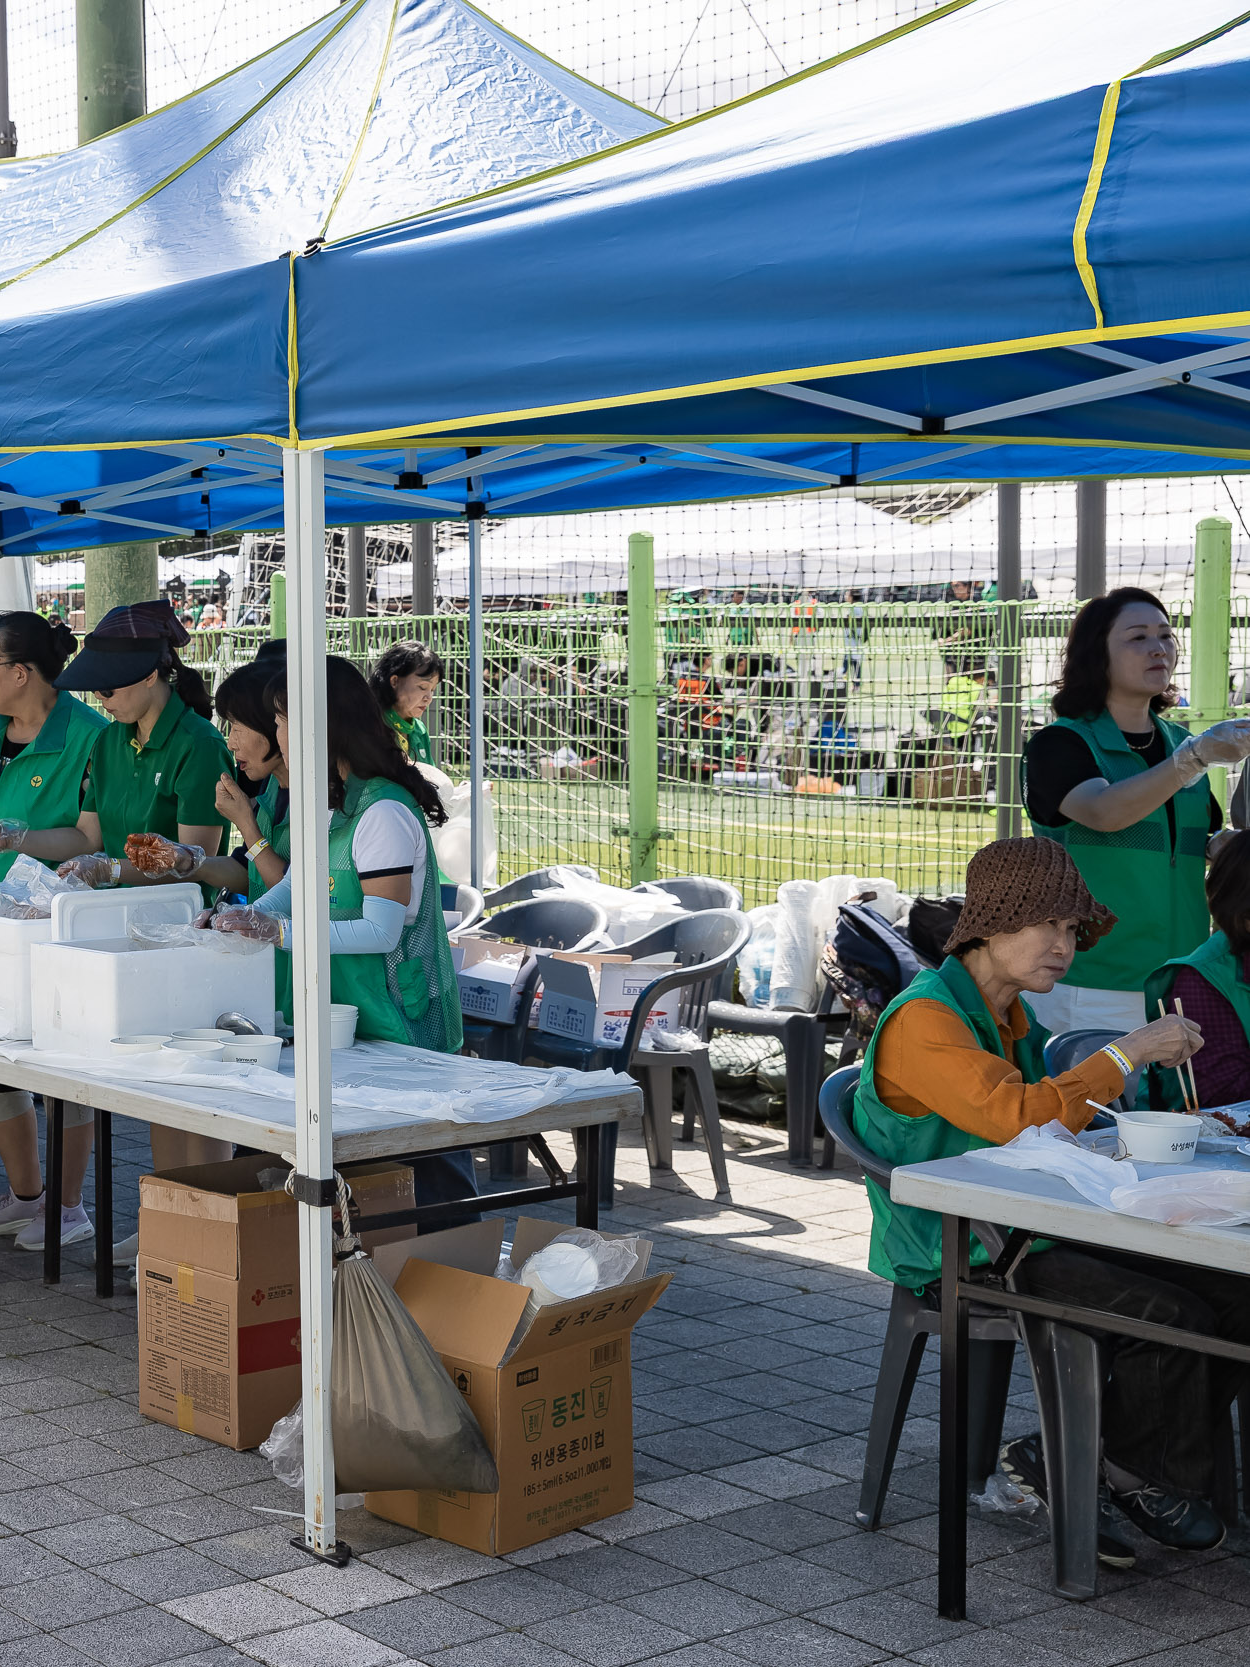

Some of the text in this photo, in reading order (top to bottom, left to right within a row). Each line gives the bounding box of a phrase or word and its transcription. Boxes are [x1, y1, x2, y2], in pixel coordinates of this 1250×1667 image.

[1170, 1141, 1195, 1152] 삼성화재
[267, 1289, 293, 1300] 포천한과
[548, 1295, 638, 1336] 횡적금지
[551, 1389, 585, 1428] 동진
[531, 1429, 605, 1471] 위생용종이컵
